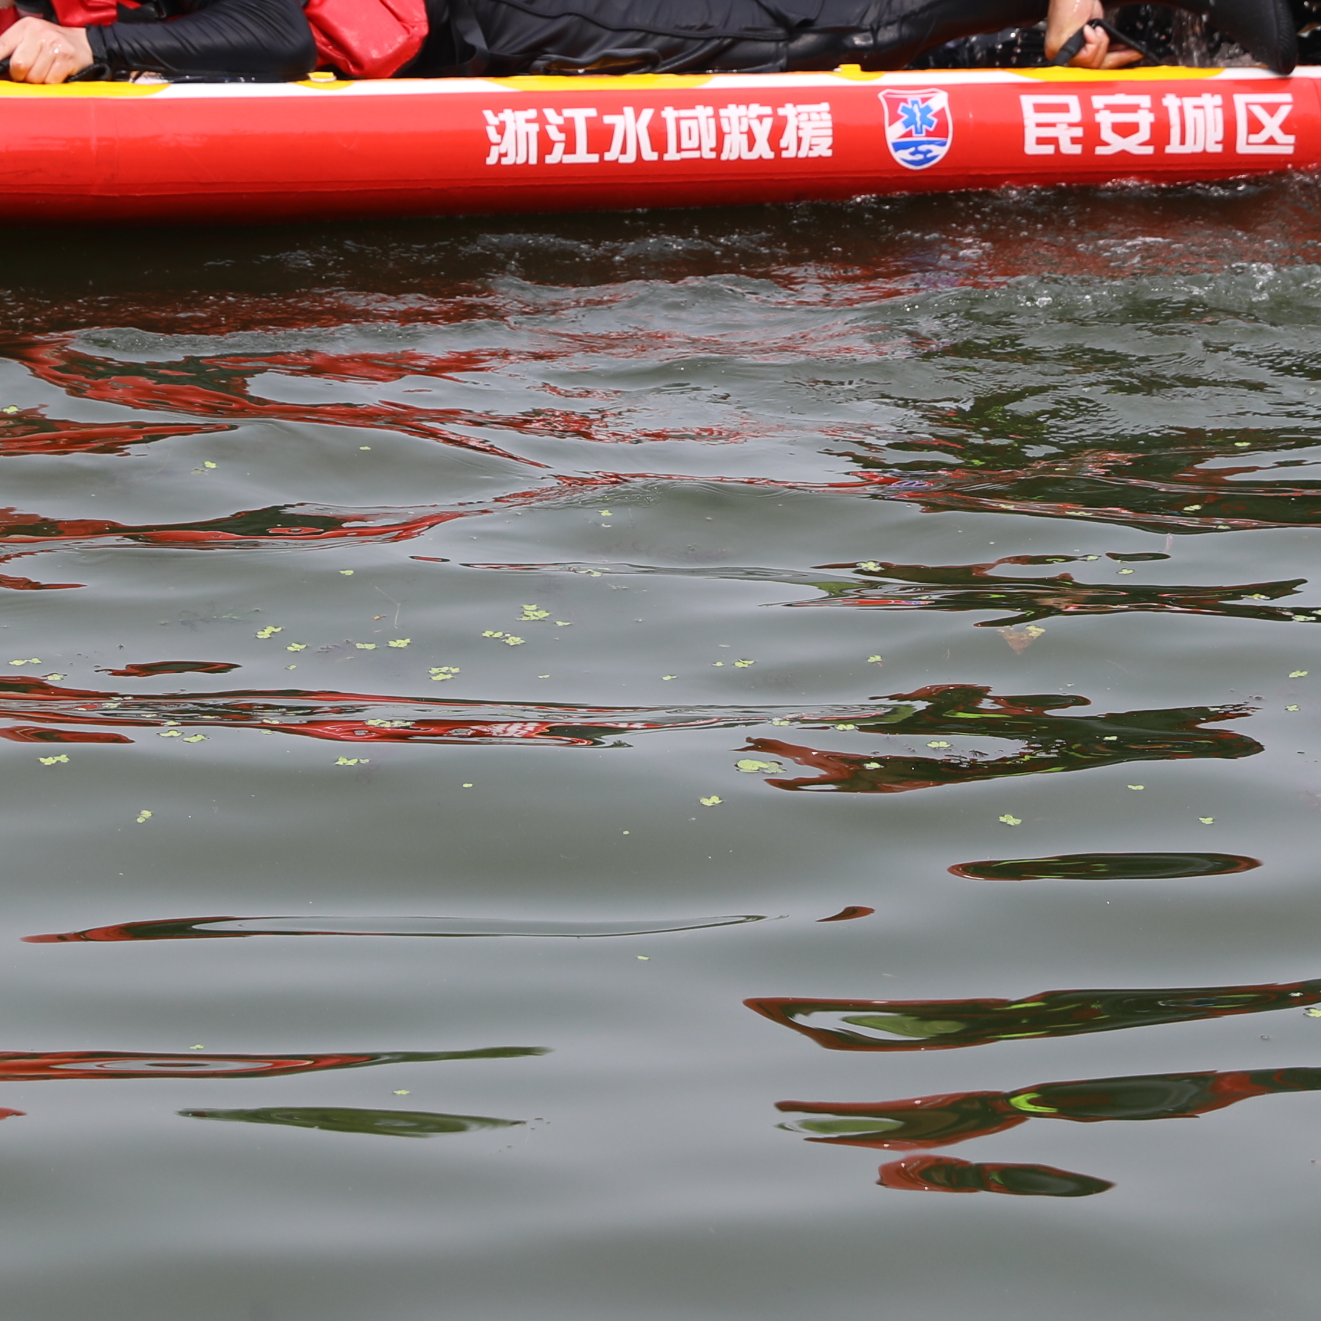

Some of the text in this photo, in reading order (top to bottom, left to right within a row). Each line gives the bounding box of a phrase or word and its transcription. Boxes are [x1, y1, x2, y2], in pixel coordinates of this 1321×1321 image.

[482, 102, 834, 165] 浙江水域救援
[1019, 93, 1296, 155] 民安城区
